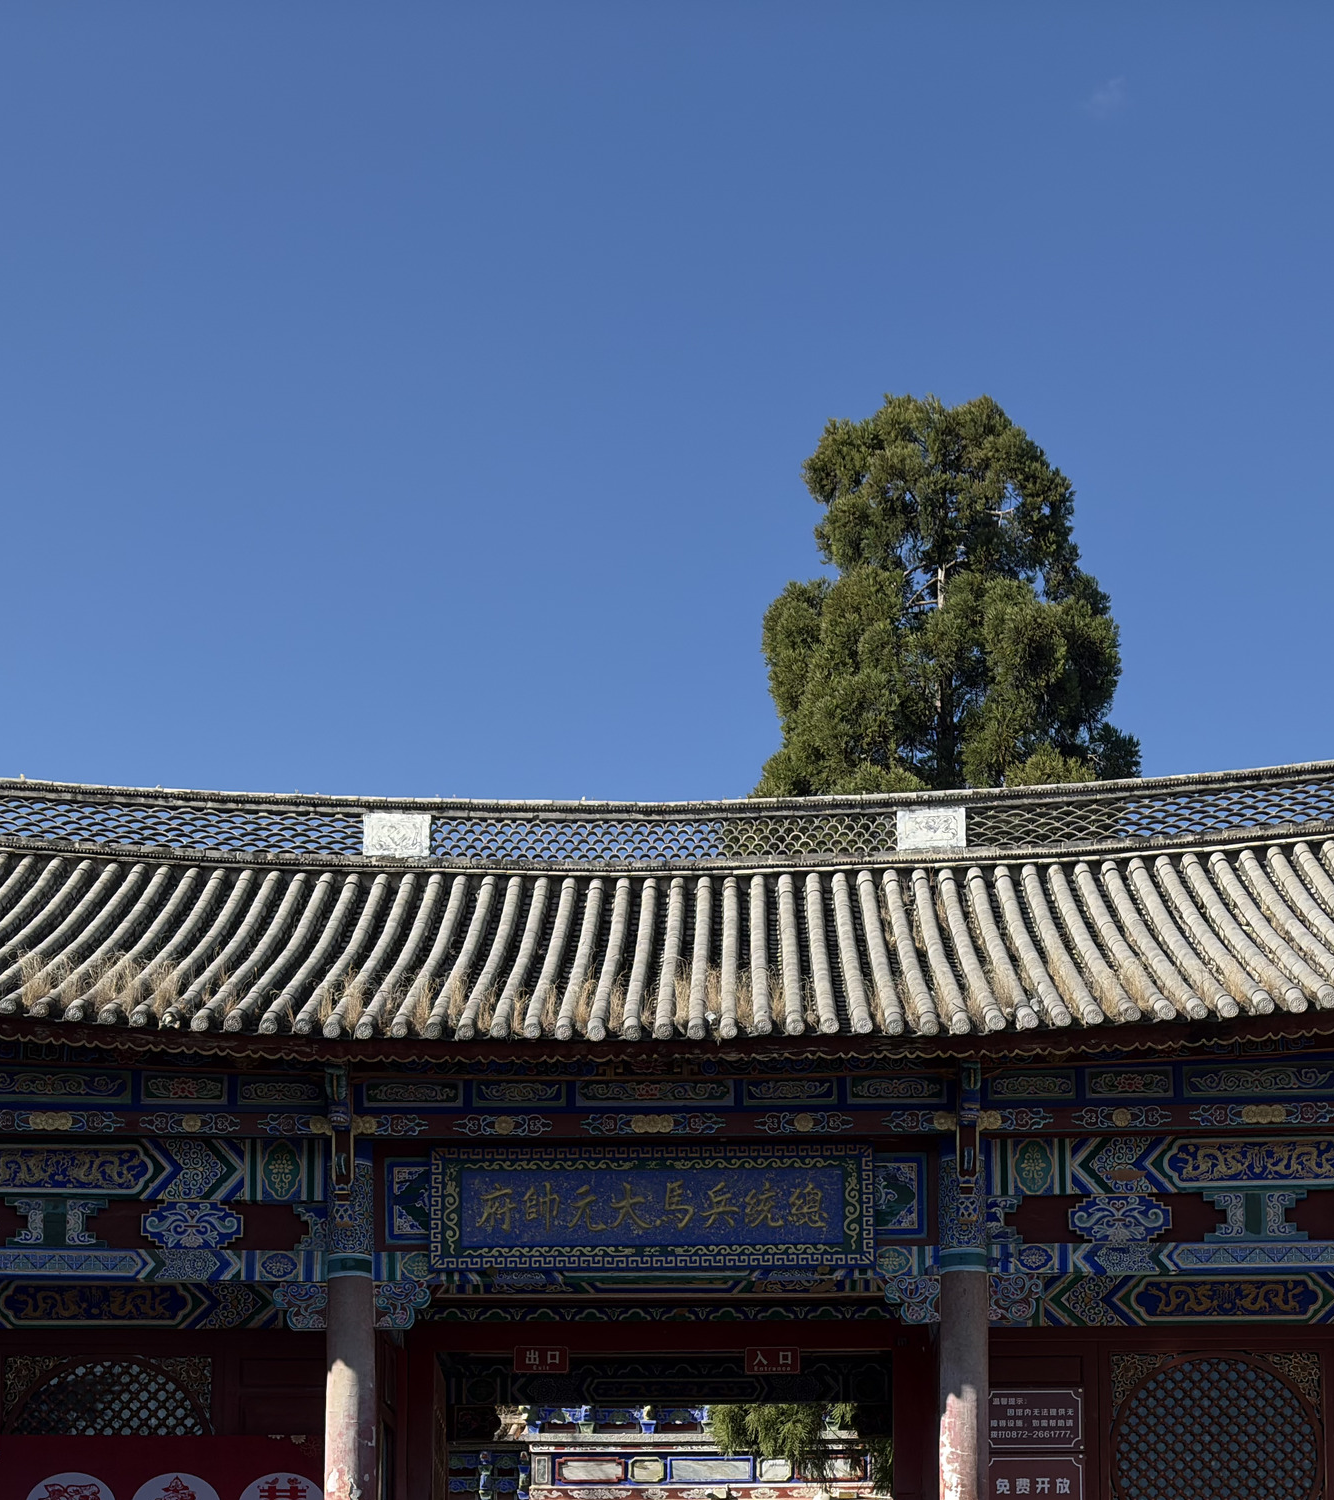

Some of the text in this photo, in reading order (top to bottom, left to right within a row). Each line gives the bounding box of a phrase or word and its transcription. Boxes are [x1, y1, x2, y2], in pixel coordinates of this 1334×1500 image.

[476, 1181, 829, 1234] 總統兵馬大元帥府
[525, 1349, 560, 1365] 出口
[752, 1350, 792, 1366] 入口
[995, 1477, 1071, 1495] 免费开放
